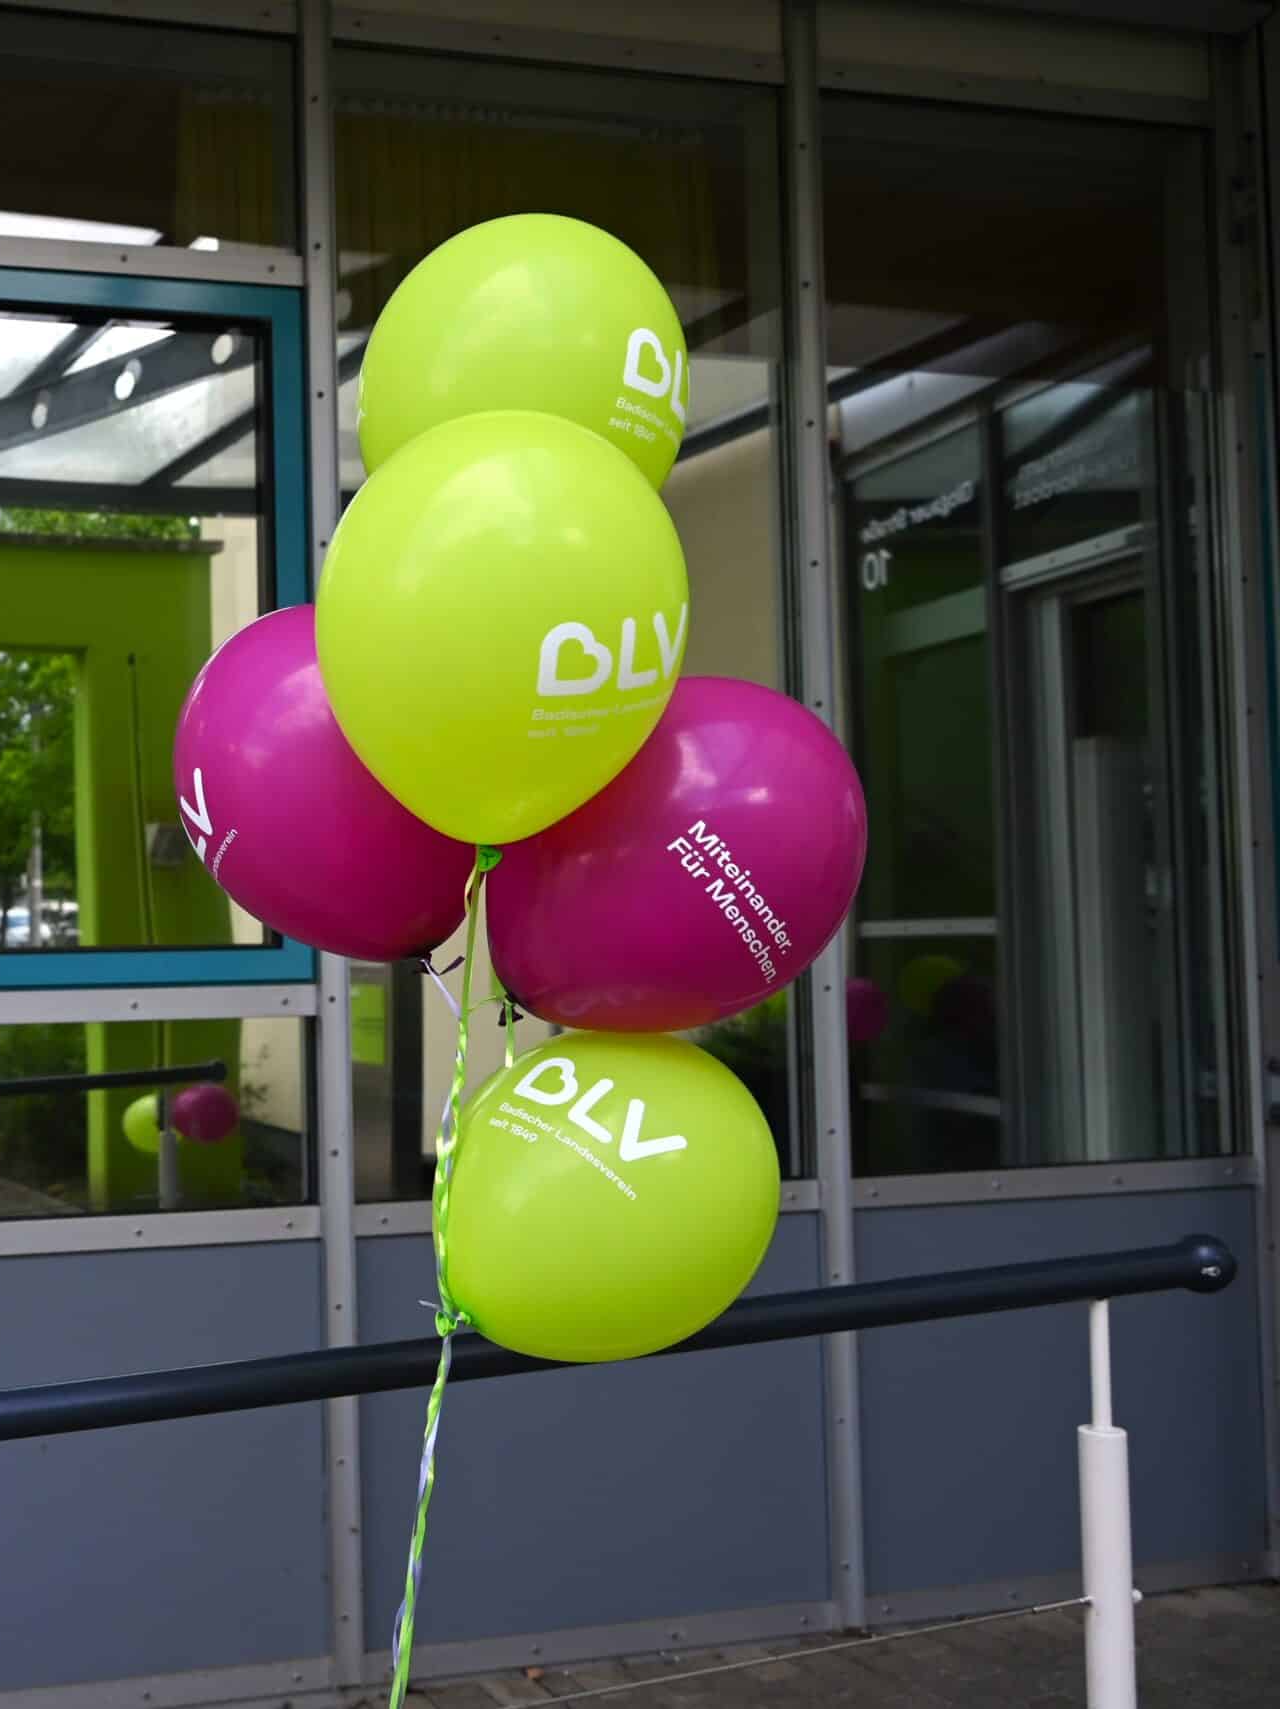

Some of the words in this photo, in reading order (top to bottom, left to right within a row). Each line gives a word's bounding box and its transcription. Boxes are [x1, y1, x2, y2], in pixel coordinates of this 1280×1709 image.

[623, 328, 686, 424] BL
[536, 601, 688, 696] BLV
[666, 836, 711, 878] Für
[705, 878, 778, 984] Menschen.
[687, 820, 792, 955] Miteinander.
[513, 1057, 688, 1162] BLV
